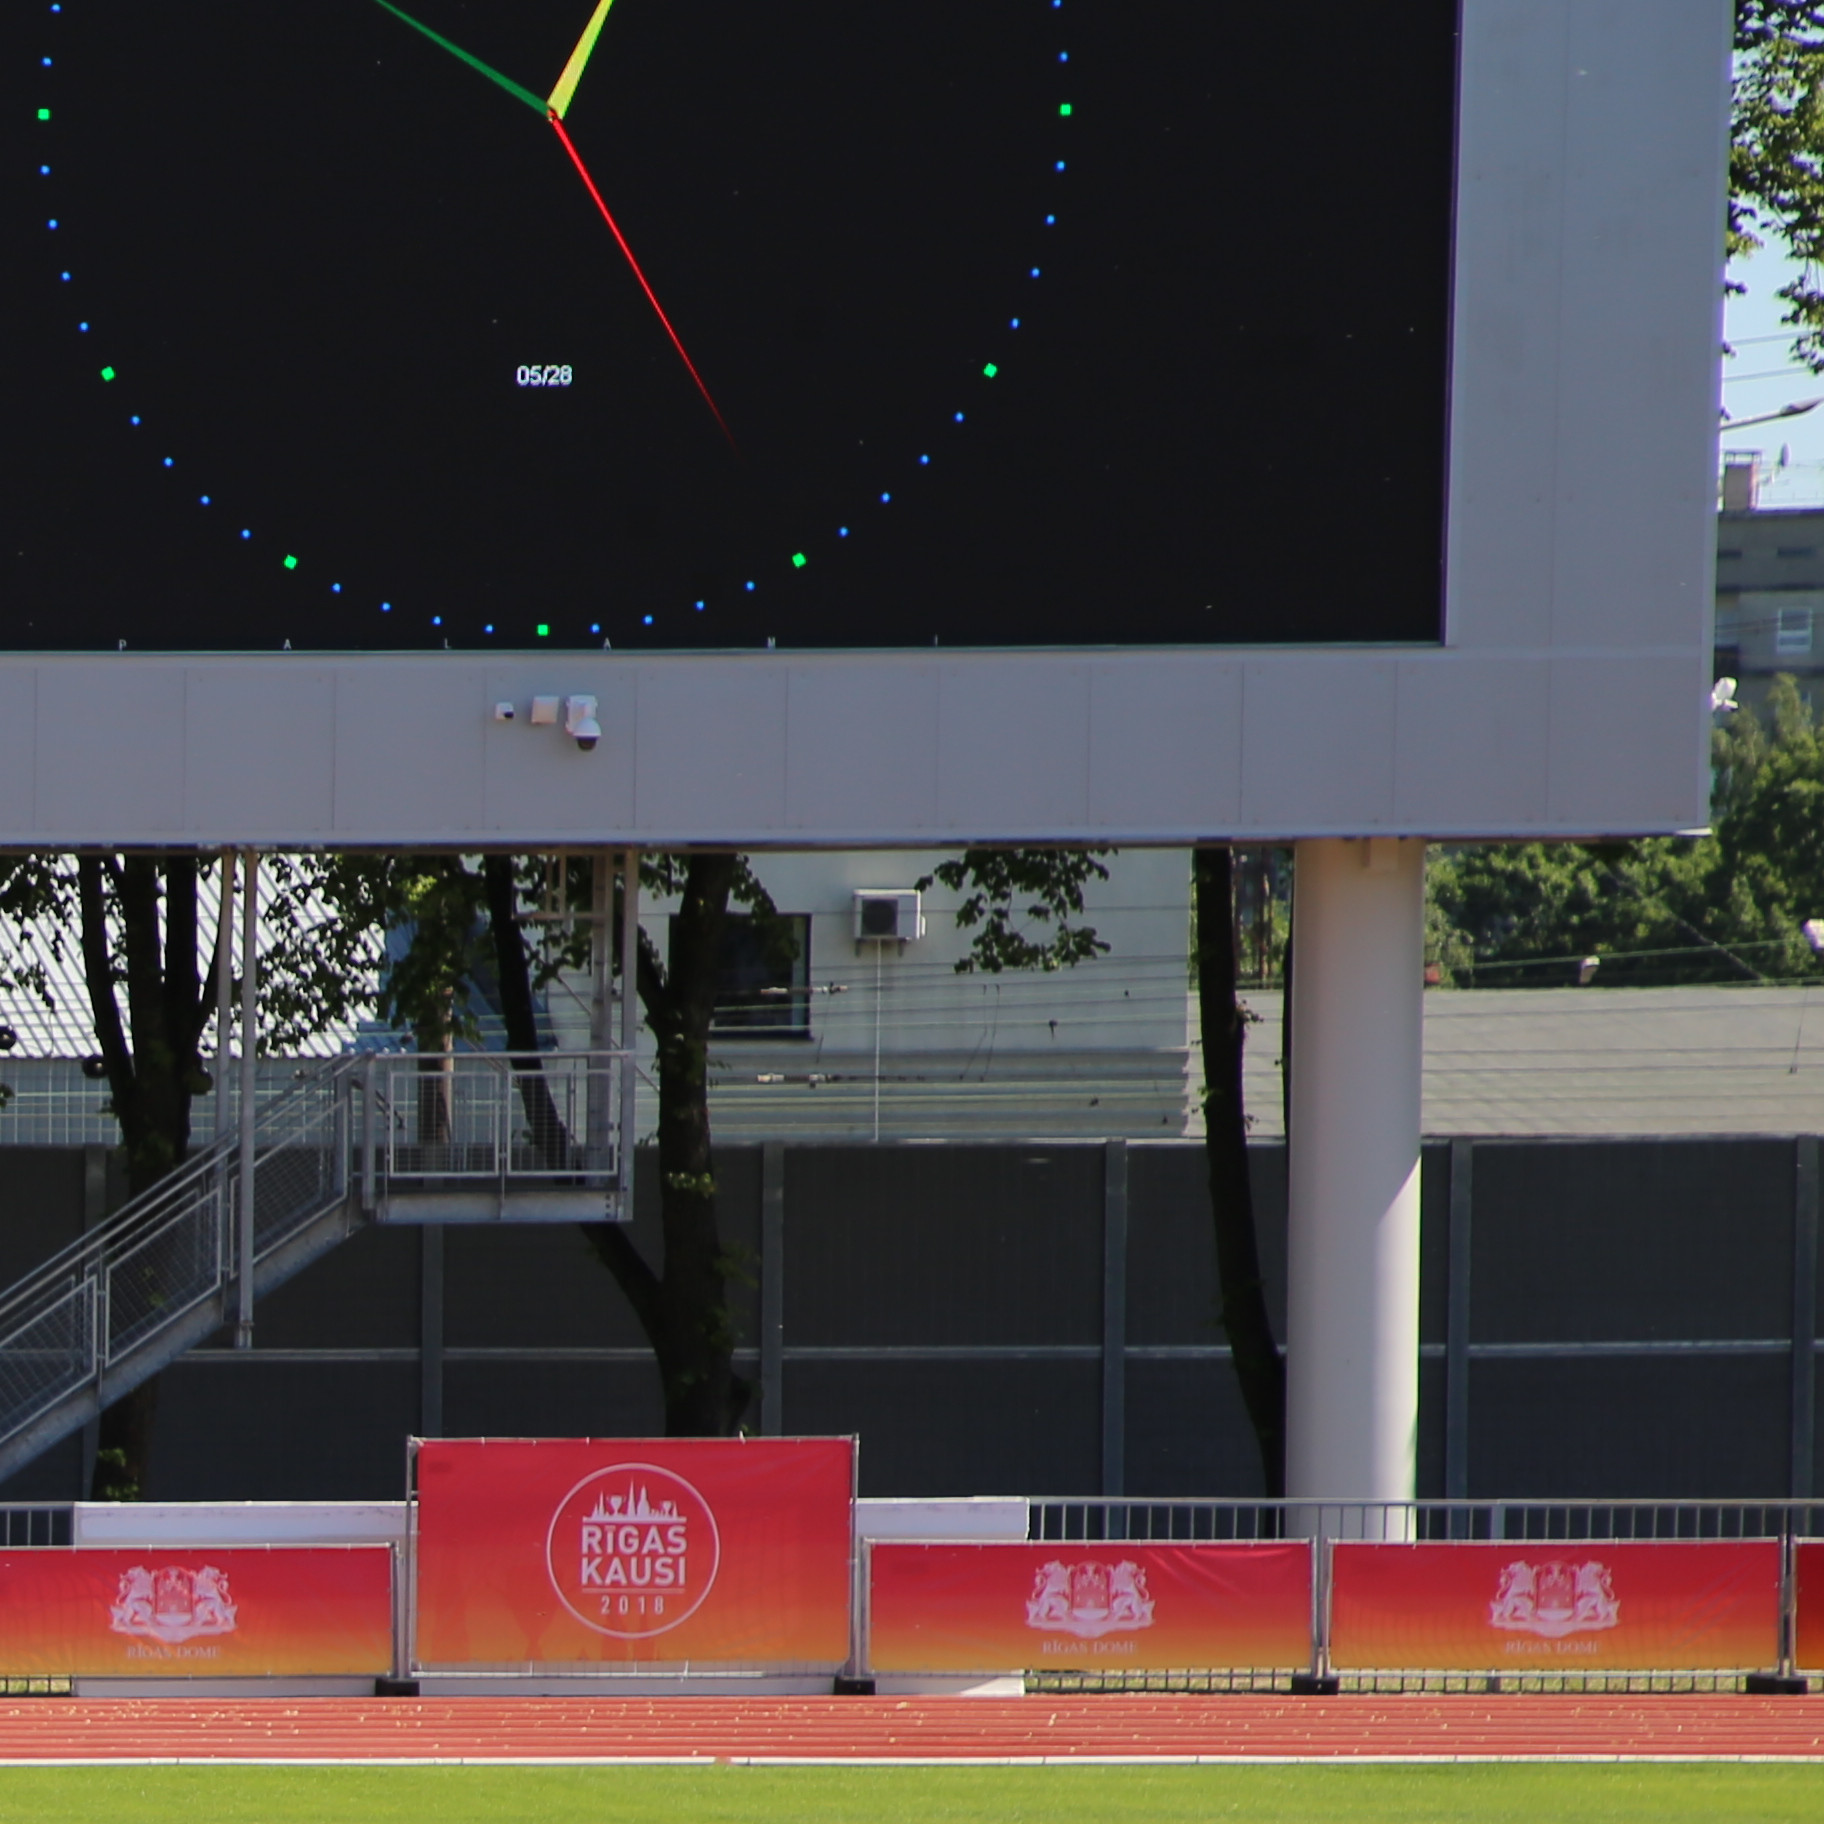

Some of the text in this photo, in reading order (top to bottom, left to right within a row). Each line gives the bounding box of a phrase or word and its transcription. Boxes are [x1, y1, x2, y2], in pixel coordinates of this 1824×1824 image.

[516, 364, 573, 386] 05/28
[581, 1525, 688, 1555] RĪGAS
[581, 1557, 686, 1586] KAUSI
[601, 1595, 664, 1615] 2018
